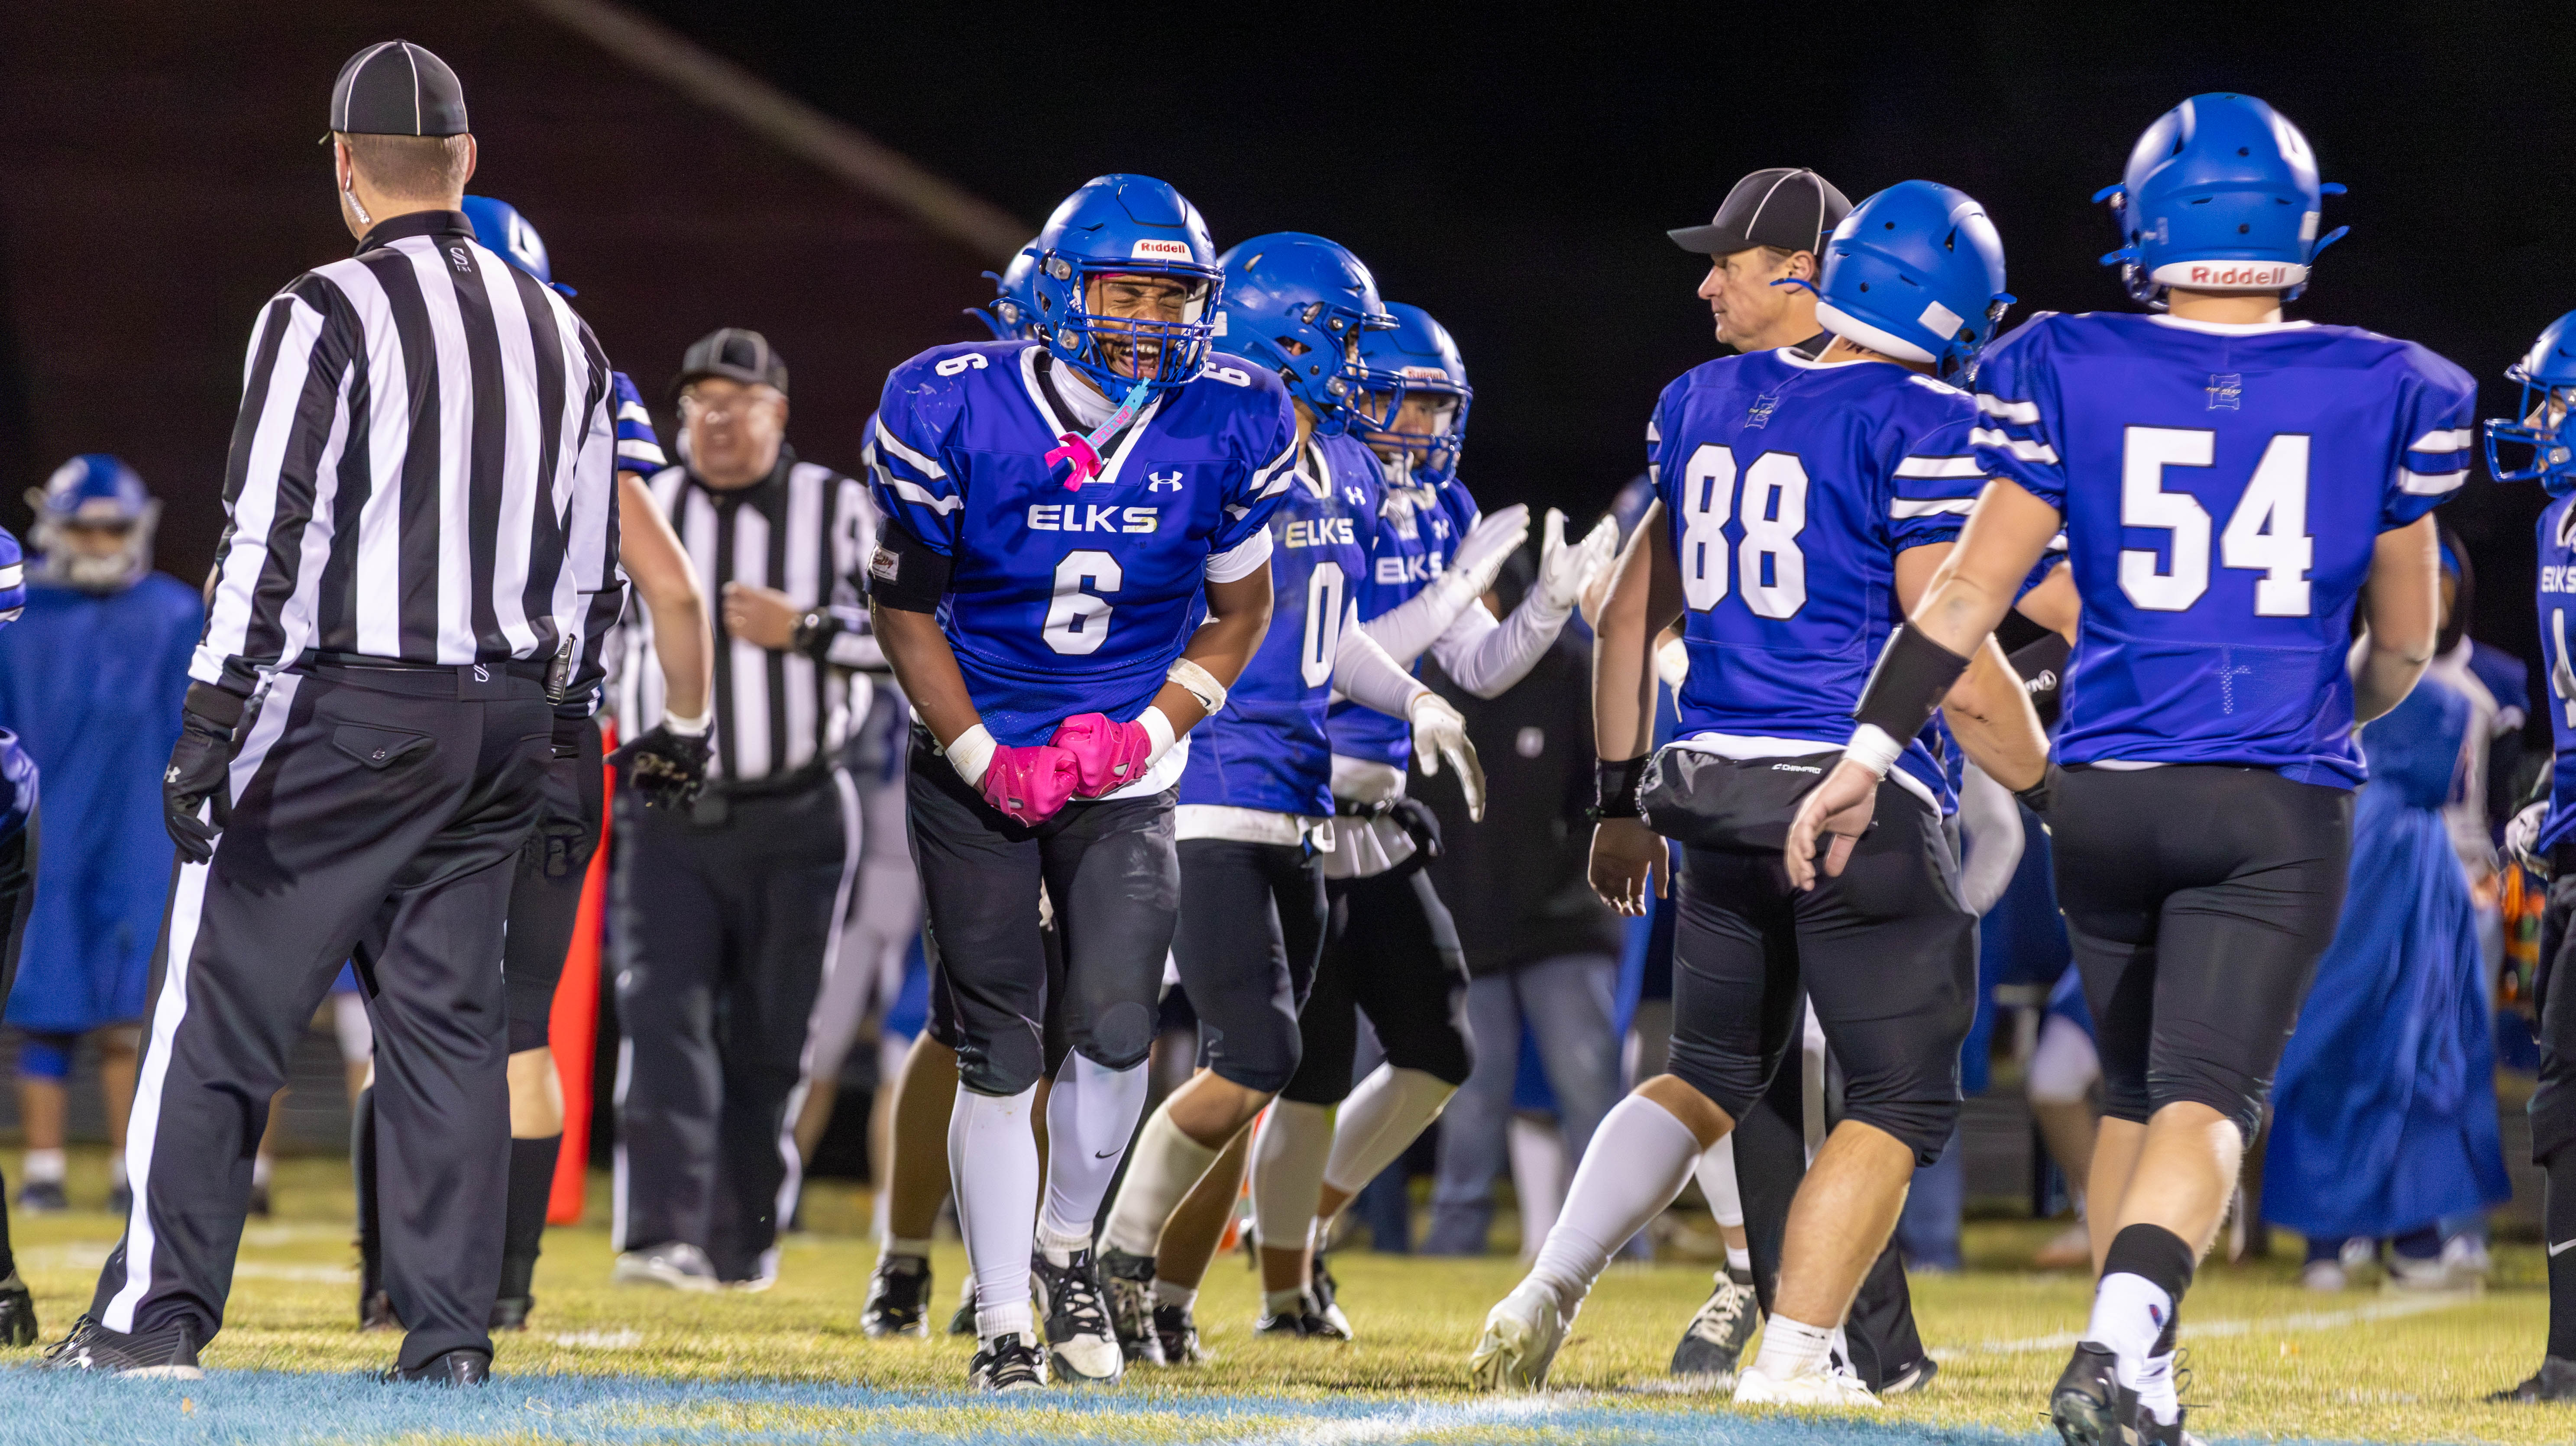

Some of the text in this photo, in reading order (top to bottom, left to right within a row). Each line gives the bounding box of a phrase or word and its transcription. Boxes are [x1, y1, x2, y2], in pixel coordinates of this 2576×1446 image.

[1141, 243, 1185, 253] Riddell
[2191, 266, 2286, 285] Riddell
[935, 353, 989, 376] 6
[1203, 361, 1251, 387] 6
[1027, 504, 1158, 533] ELKS
[1681, 442, 1809, 620] 88
[2118, 424, 2315, 617] 54
[1285, 518, 1354, 549] ELKS
[1375, 551, 1443, 585] ELKS
[2541, 565, 2576, 593] ELKS
[1042, 550, 1123, 655] 6
[1301, 562, 1344, 689] 0
[1782, 764, 1822, 774] CHAMPRO
